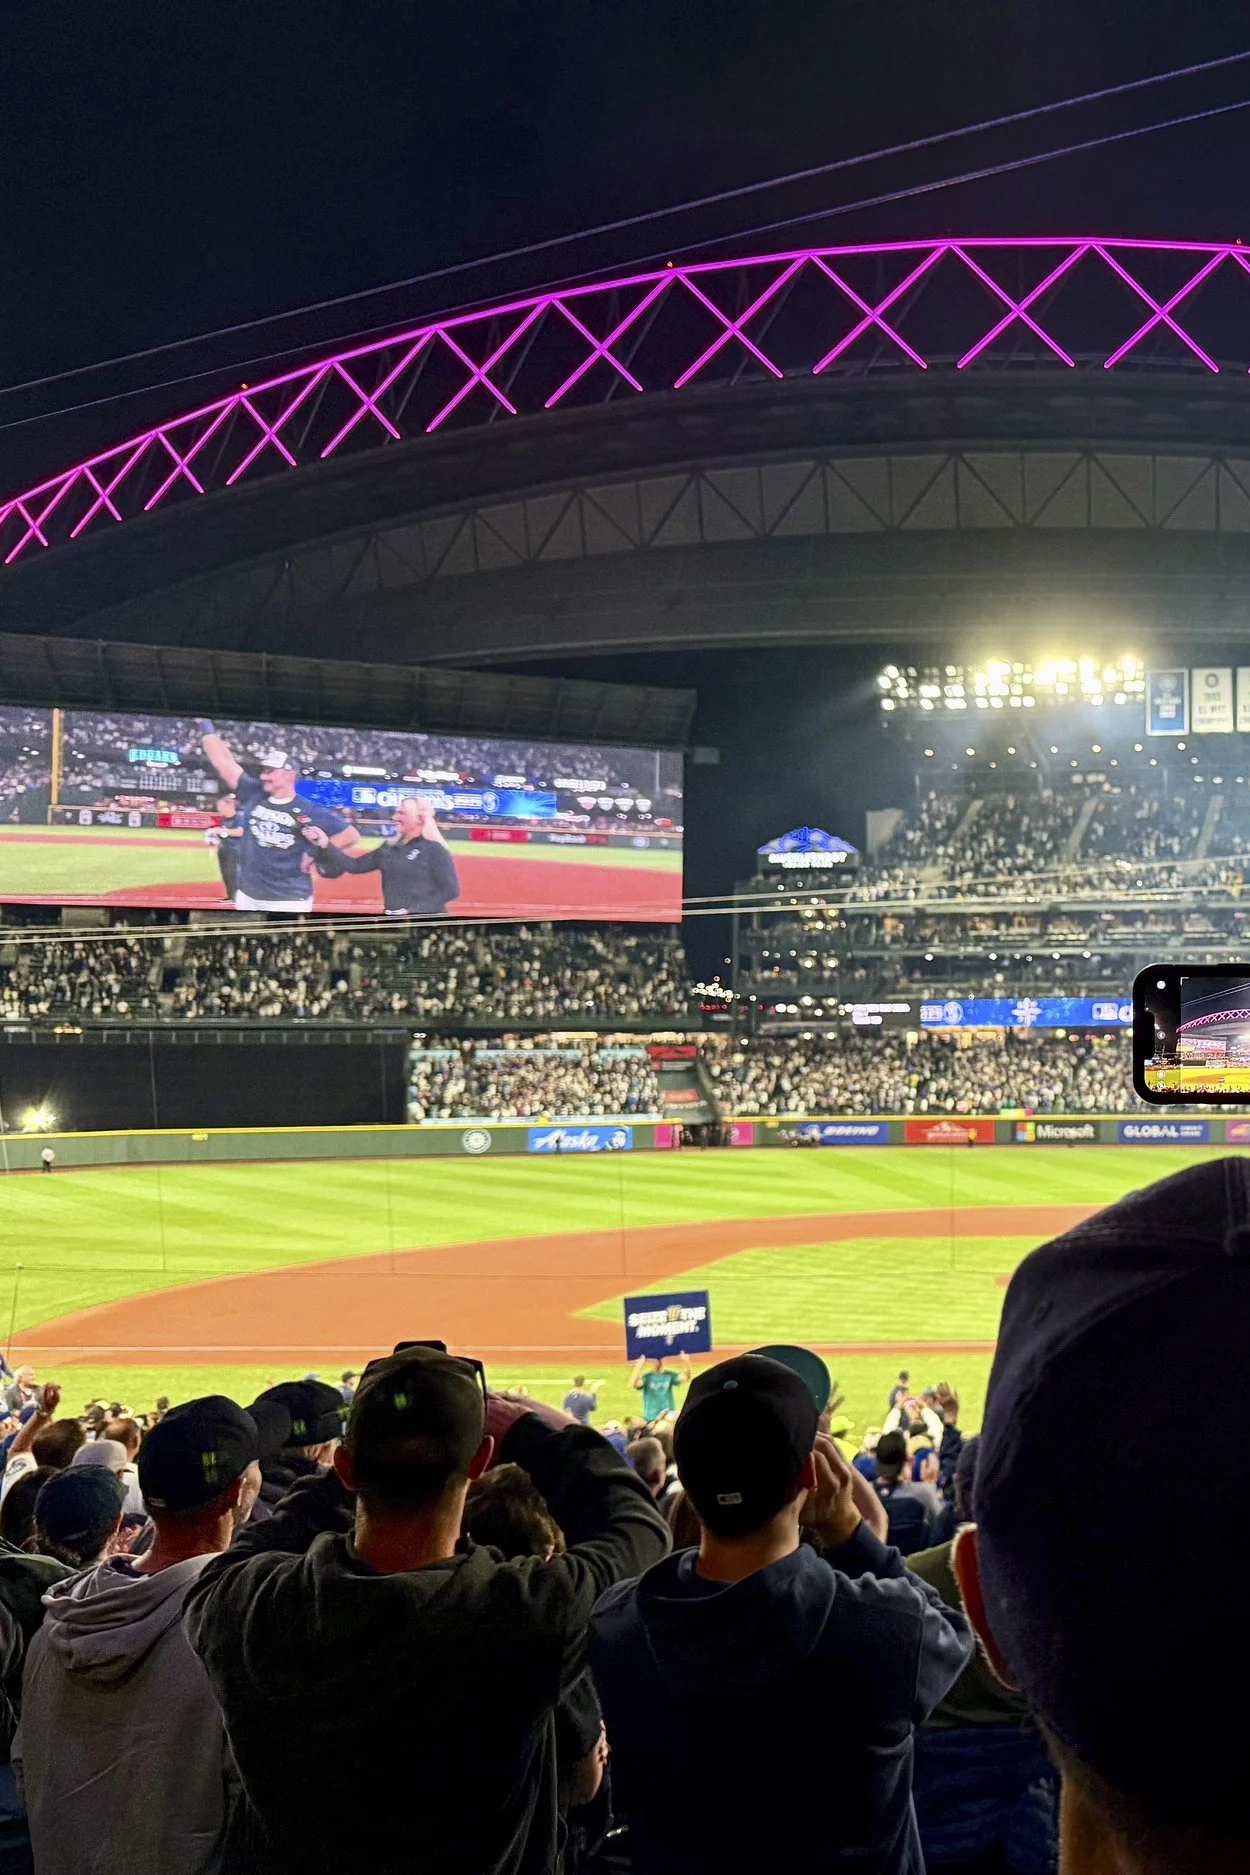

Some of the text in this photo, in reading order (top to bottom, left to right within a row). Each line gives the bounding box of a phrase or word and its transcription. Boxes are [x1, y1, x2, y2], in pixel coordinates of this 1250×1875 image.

[823, 1124, 881, 1137] BOEING
[1036, 1122, 1096, 1139] Microsoft
[1123, 1124, 1179, 1138] GLOBAL
[534, 1128, 600, 1151] Alaska
[627, 1306, 707, 1328] SEIZE THE
